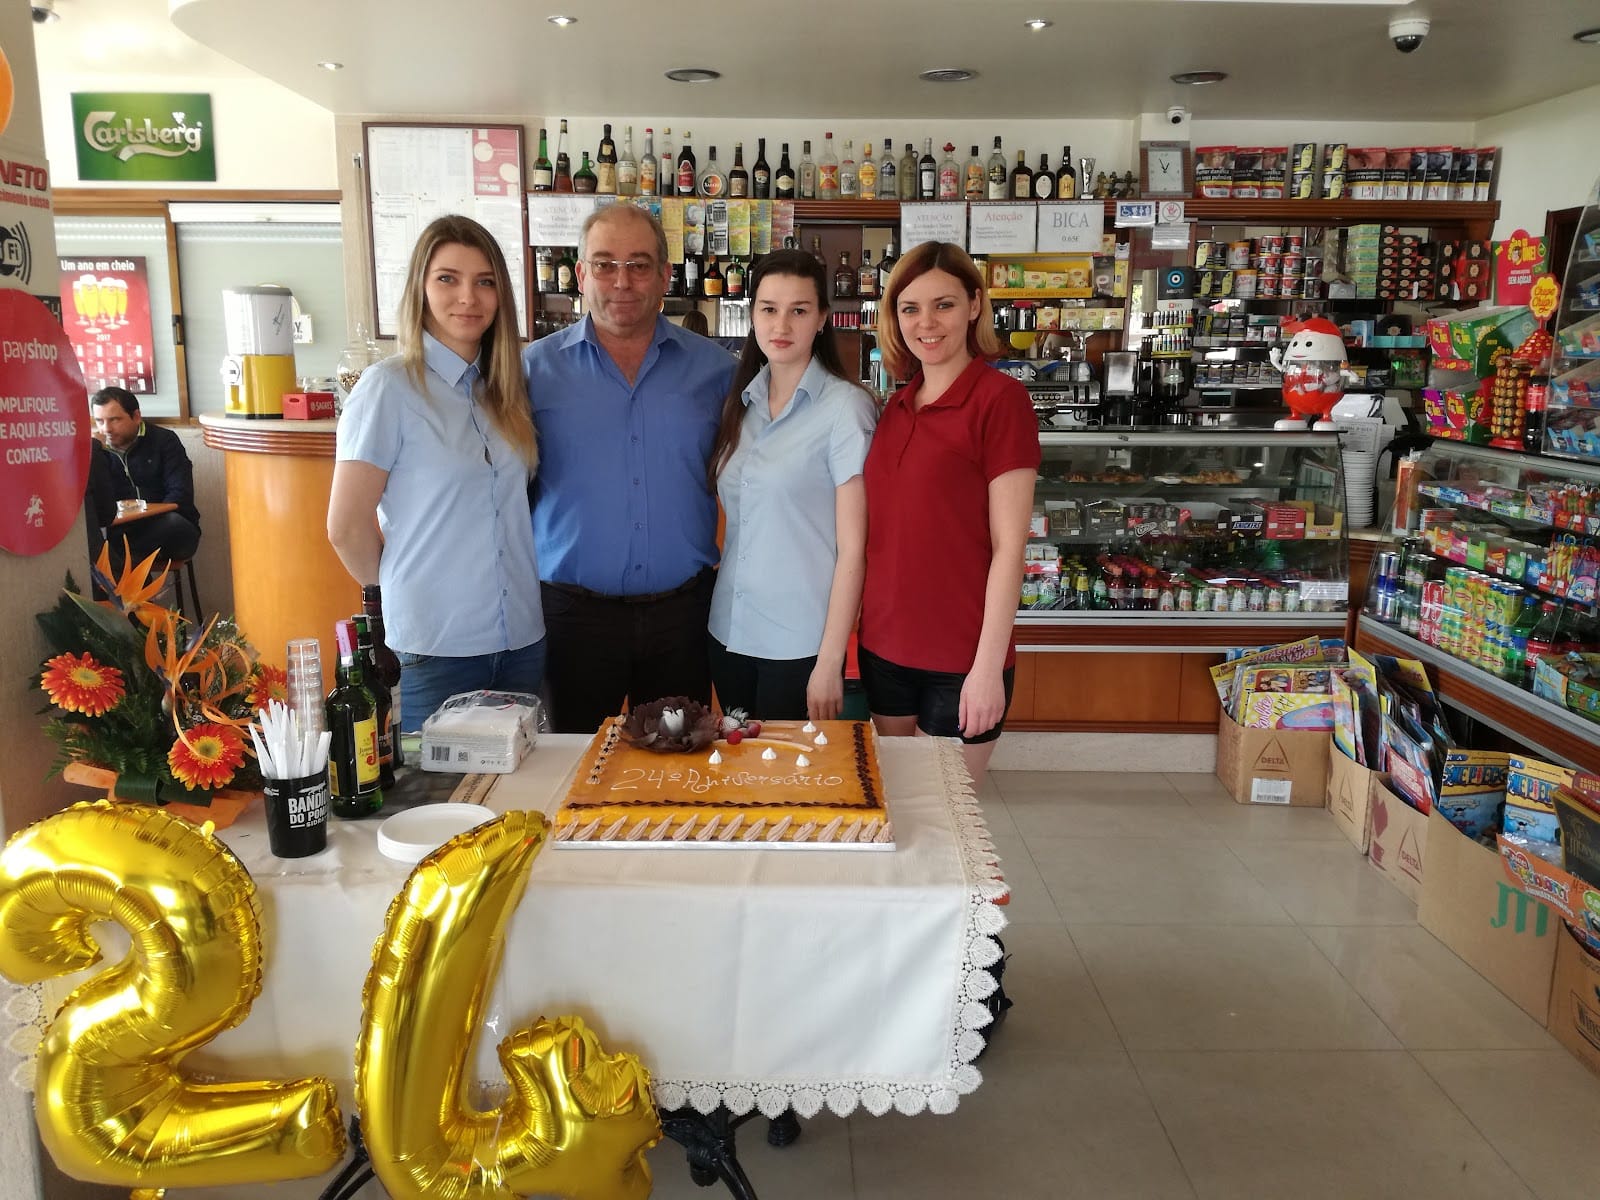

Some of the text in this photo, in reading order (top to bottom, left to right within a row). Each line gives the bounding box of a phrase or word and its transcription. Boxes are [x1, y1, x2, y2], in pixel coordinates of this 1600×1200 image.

[83, 111, 203, 160] Carlsberg
[984, 211, 1023, 222] Atenção
[1053, 211, 1090, 228] BICA
[61, 259, 136, 271] Um ano em cheio
[96, 334, 111, 342] 2017
[2, 337, 59, 366] payshop
[9, 422, 37, 441] AQUI
[38, 421, 51, 437] AS
[52, 420, 77, 437] SUAS
[6, 446, 52, 465] CONTAS.
[1261, 757, 1286, 765] DELTA
[289, 813, 305, 825] DO
[1401, 850, 1420, 871] DELTA
